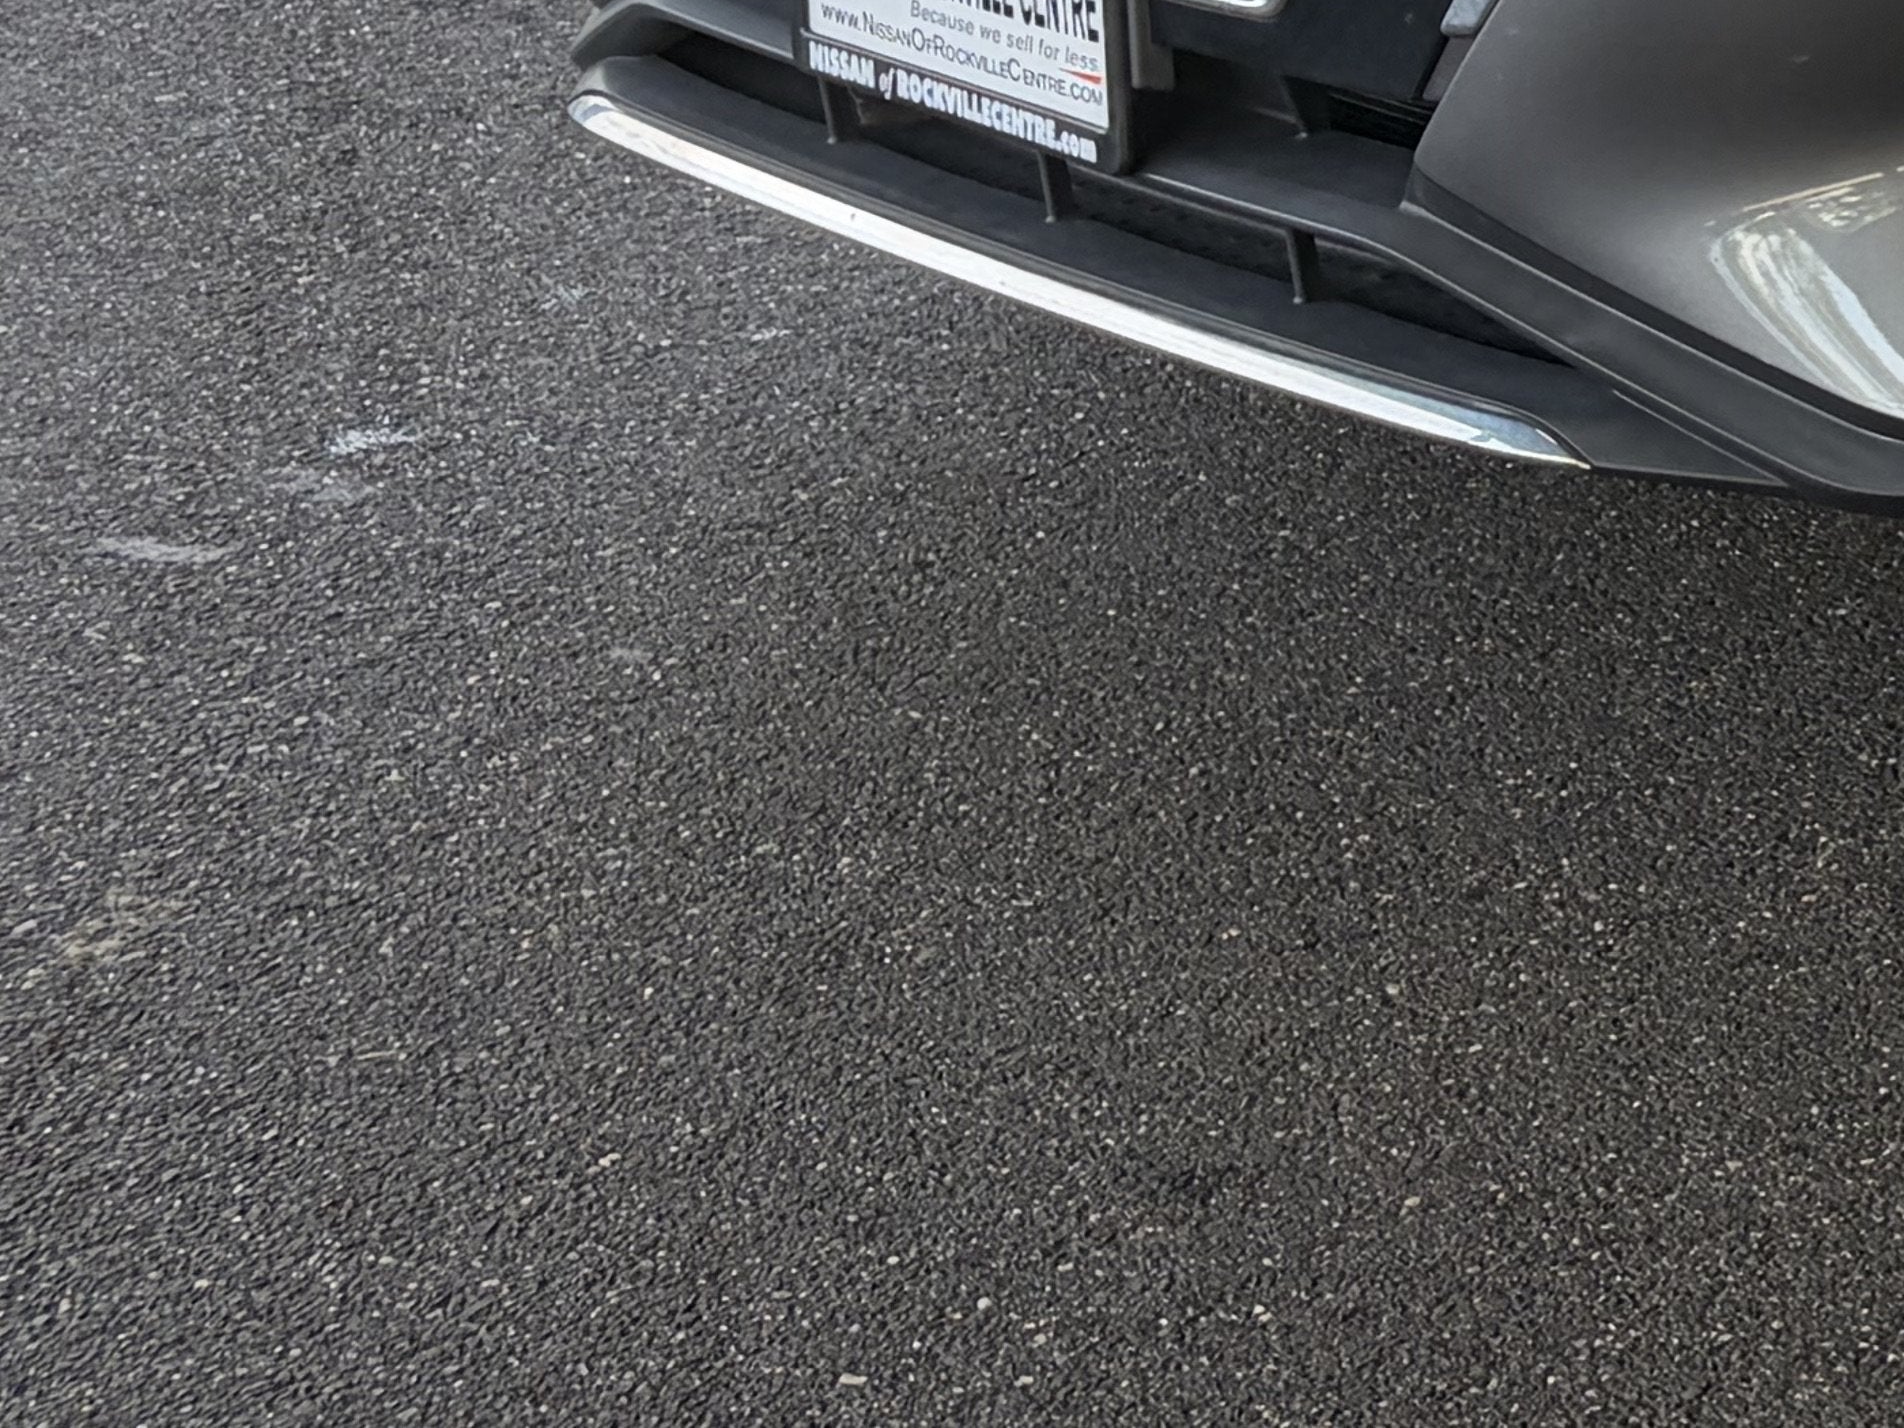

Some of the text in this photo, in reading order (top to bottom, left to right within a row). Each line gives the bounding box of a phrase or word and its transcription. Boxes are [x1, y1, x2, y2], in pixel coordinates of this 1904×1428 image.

[910, 0, 1099, 72] Because we sell for less
